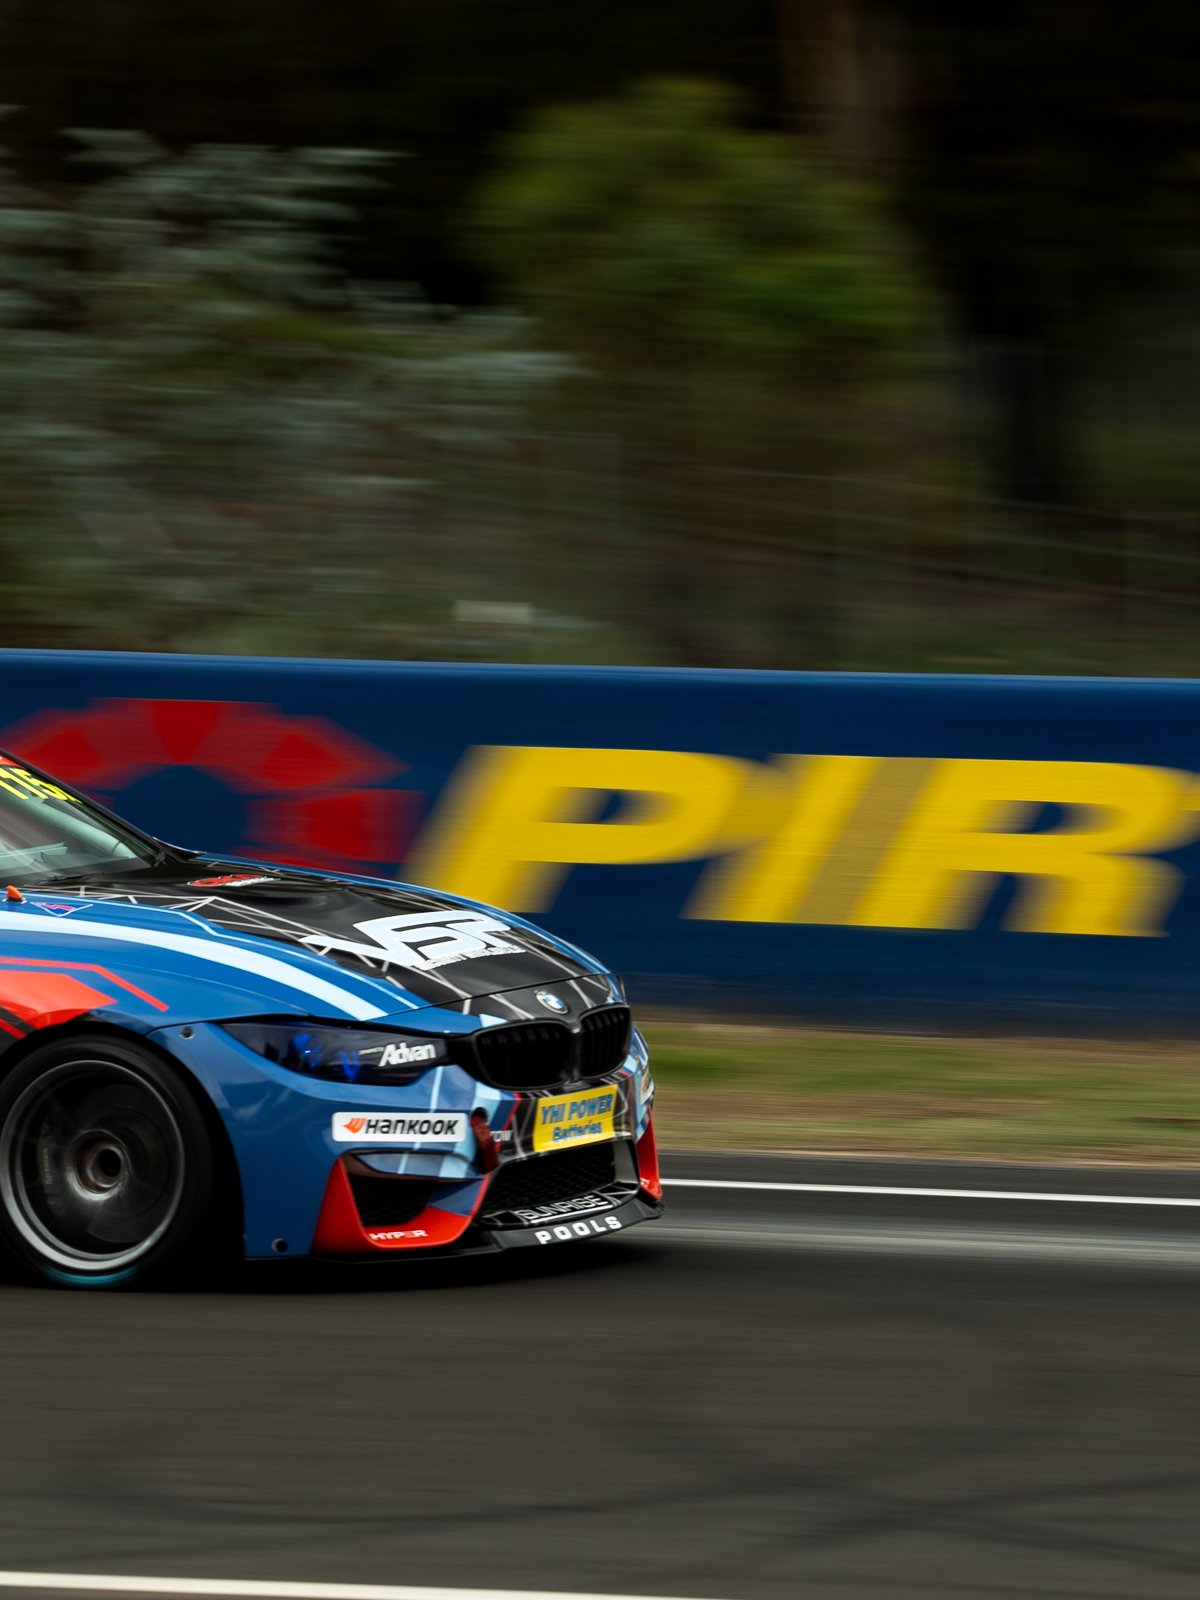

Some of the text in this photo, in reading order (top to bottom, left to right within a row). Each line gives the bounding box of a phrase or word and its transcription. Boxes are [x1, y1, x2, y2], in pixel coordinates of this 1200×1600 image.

[400, 744, 1200, 938] PIR
[378, 1042, 437, 1067] Advan
[541, 1094, 614, 1125] YHI POWER
[553, 1120, 603, 1142] Batteries
[513, 1195, 609, 1220] SUNRISE
[534, 1216, 623, 1245] POOLS
